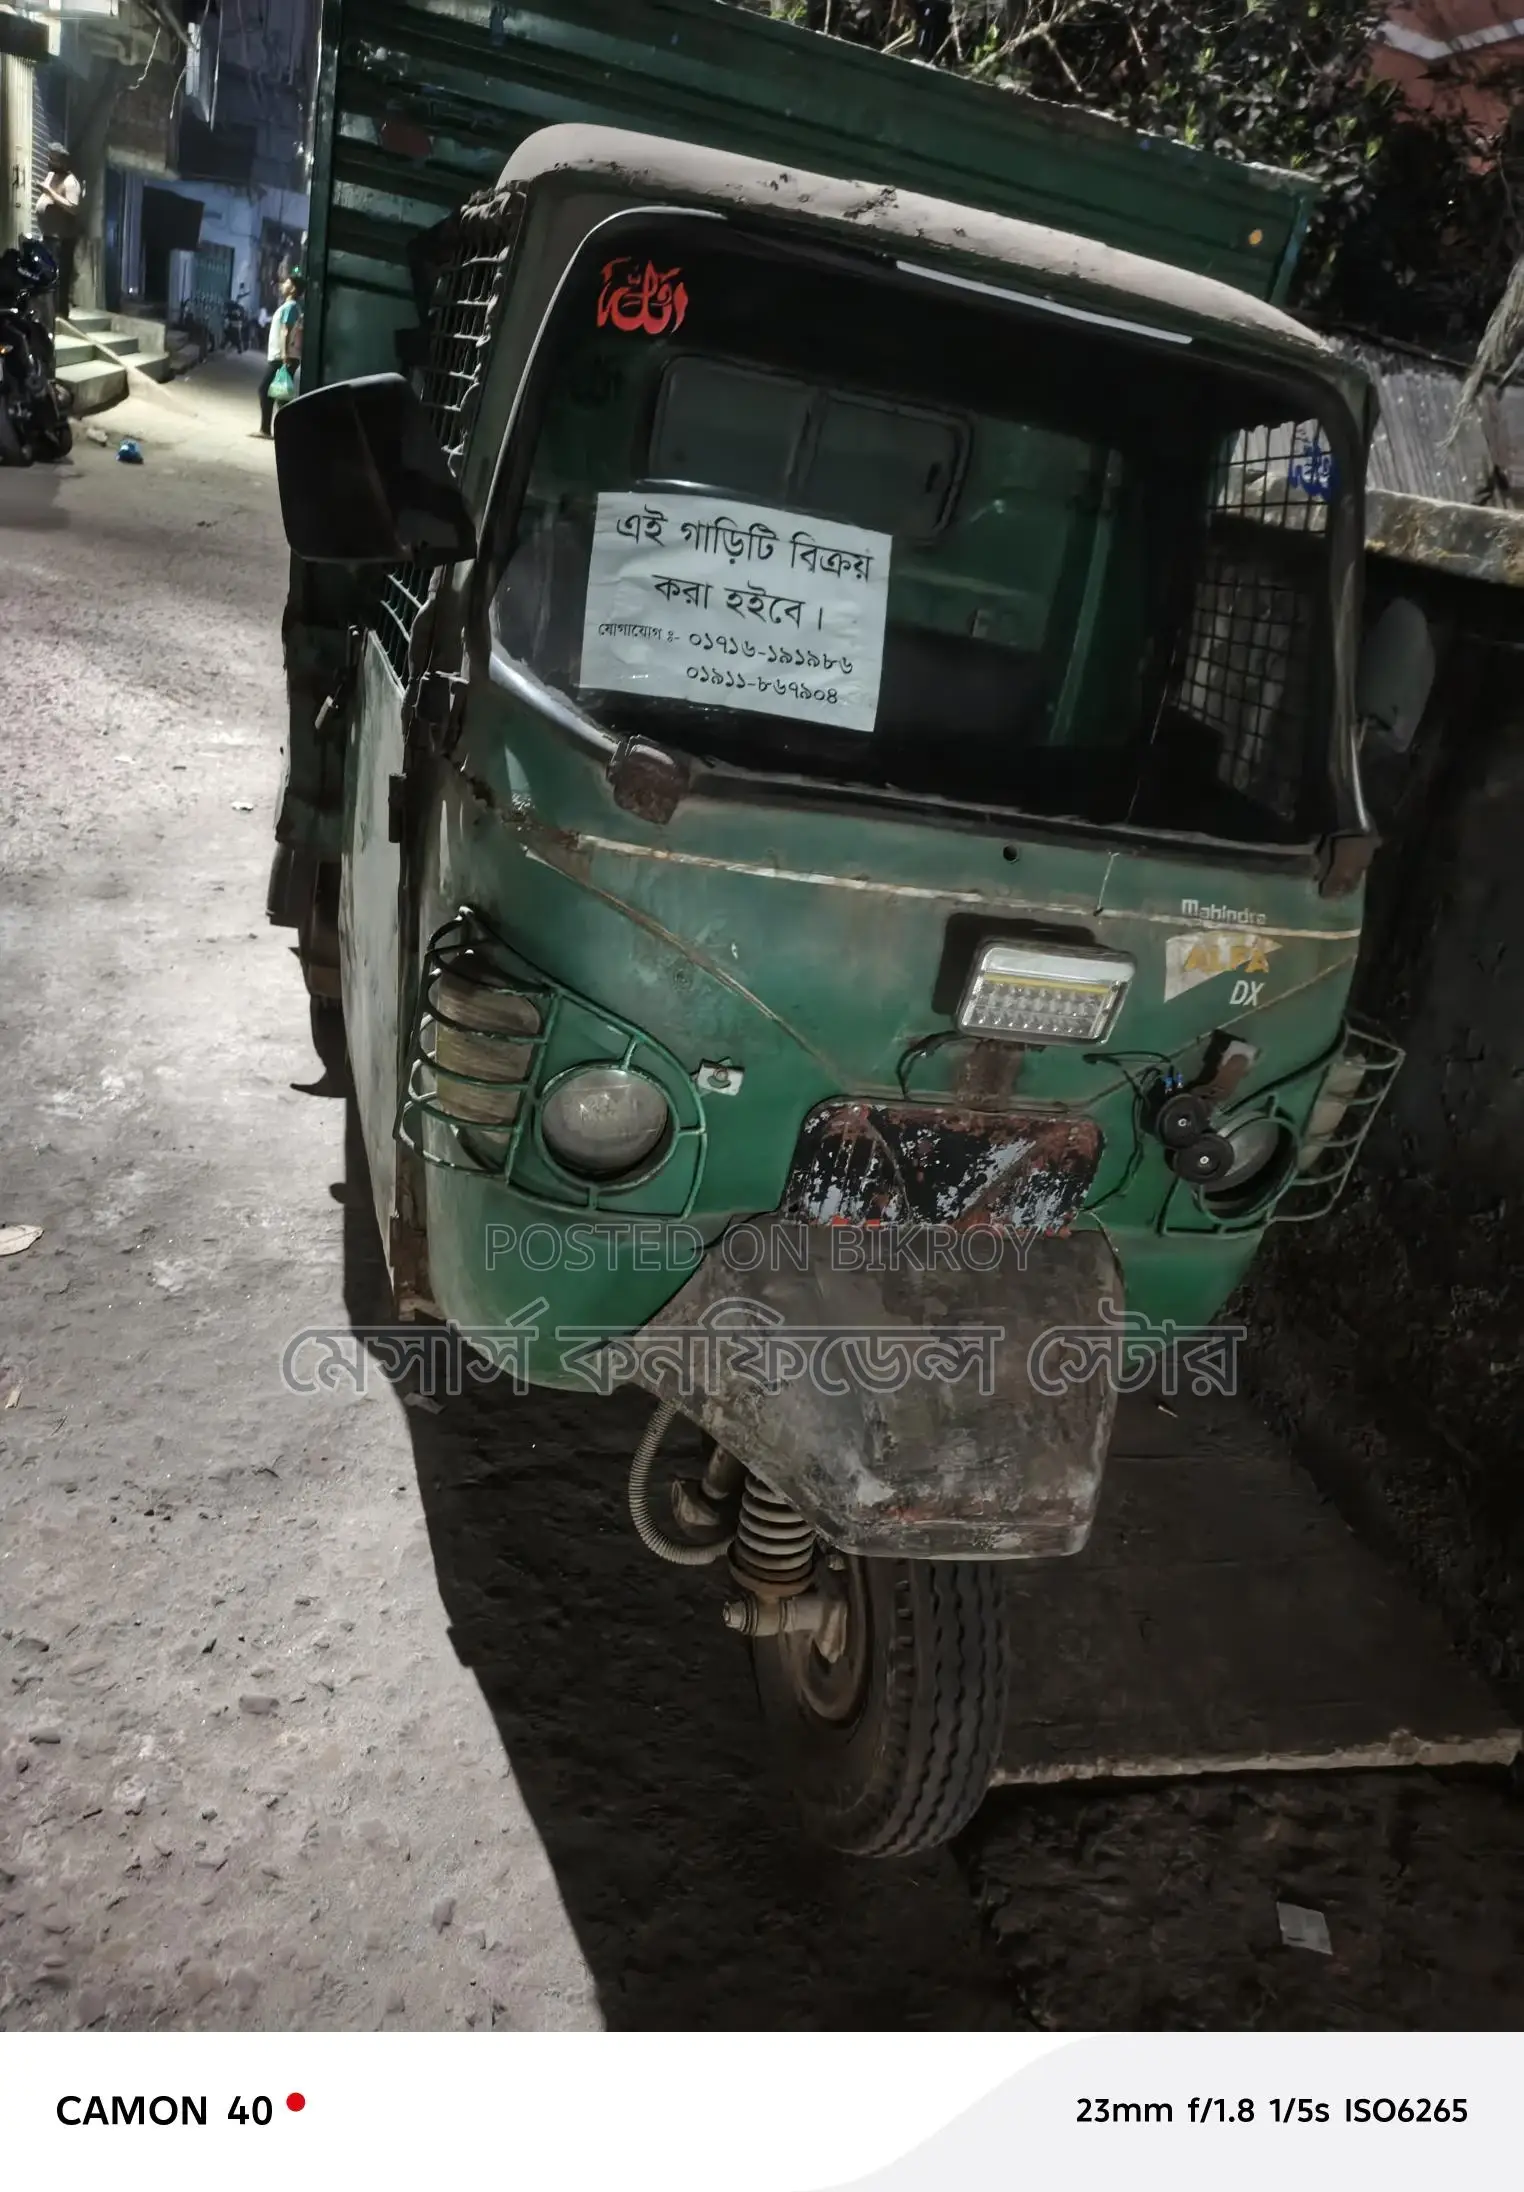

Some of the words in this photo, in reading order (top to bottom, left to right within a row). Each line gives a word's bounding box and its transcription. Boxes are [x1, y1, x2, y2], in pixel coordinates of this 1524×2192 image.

[616, 504, 669, 547] এই
[680, 516, 780, 565] গাড়িটি
[788, 531, 875, 582] বিক্রয়
[651, 574, 713, 610] করা
[723, 580, 806, 629] হইবে
[598, 623, 663, 640] যোগাযোগ
[688, 632, 854, 674] ০১৭১৬-১৯১৯৮৬
[686, 665, 838, 704] ০১৯১১-৮৬৭৯০৪
[1229, 979, 1266, 1007] DX
